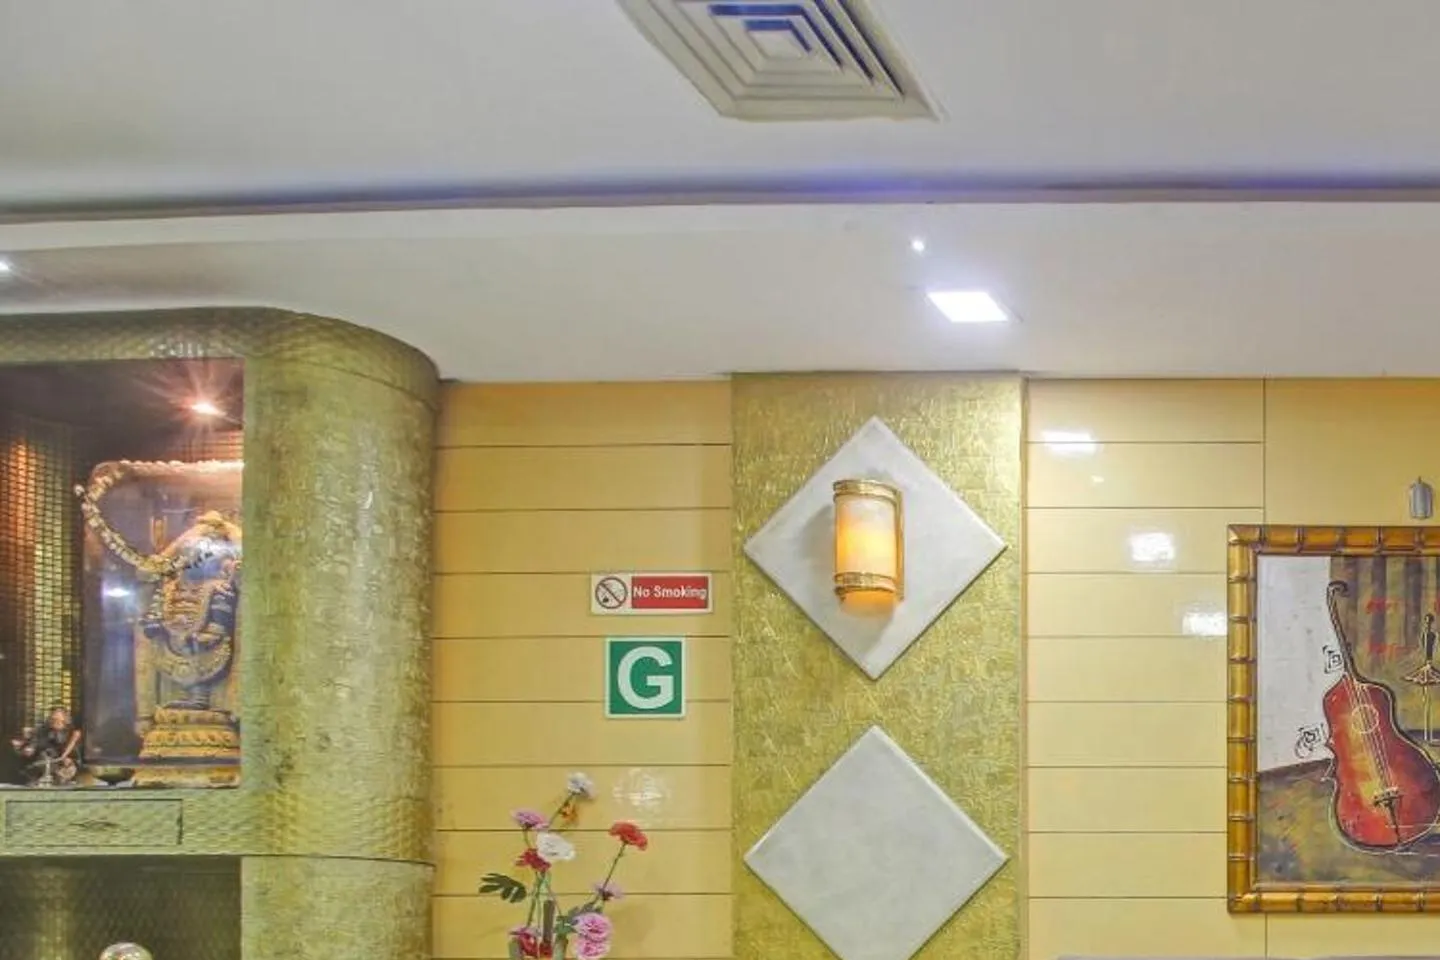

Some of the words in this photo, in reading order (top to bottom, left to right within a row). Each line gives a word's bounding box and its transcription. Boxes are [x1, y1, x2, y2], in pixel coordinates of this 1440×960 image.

[633, 585, 650, 598] No
[654, 585, 707, 600] Smoking
[617, 646, 674, 709] G
